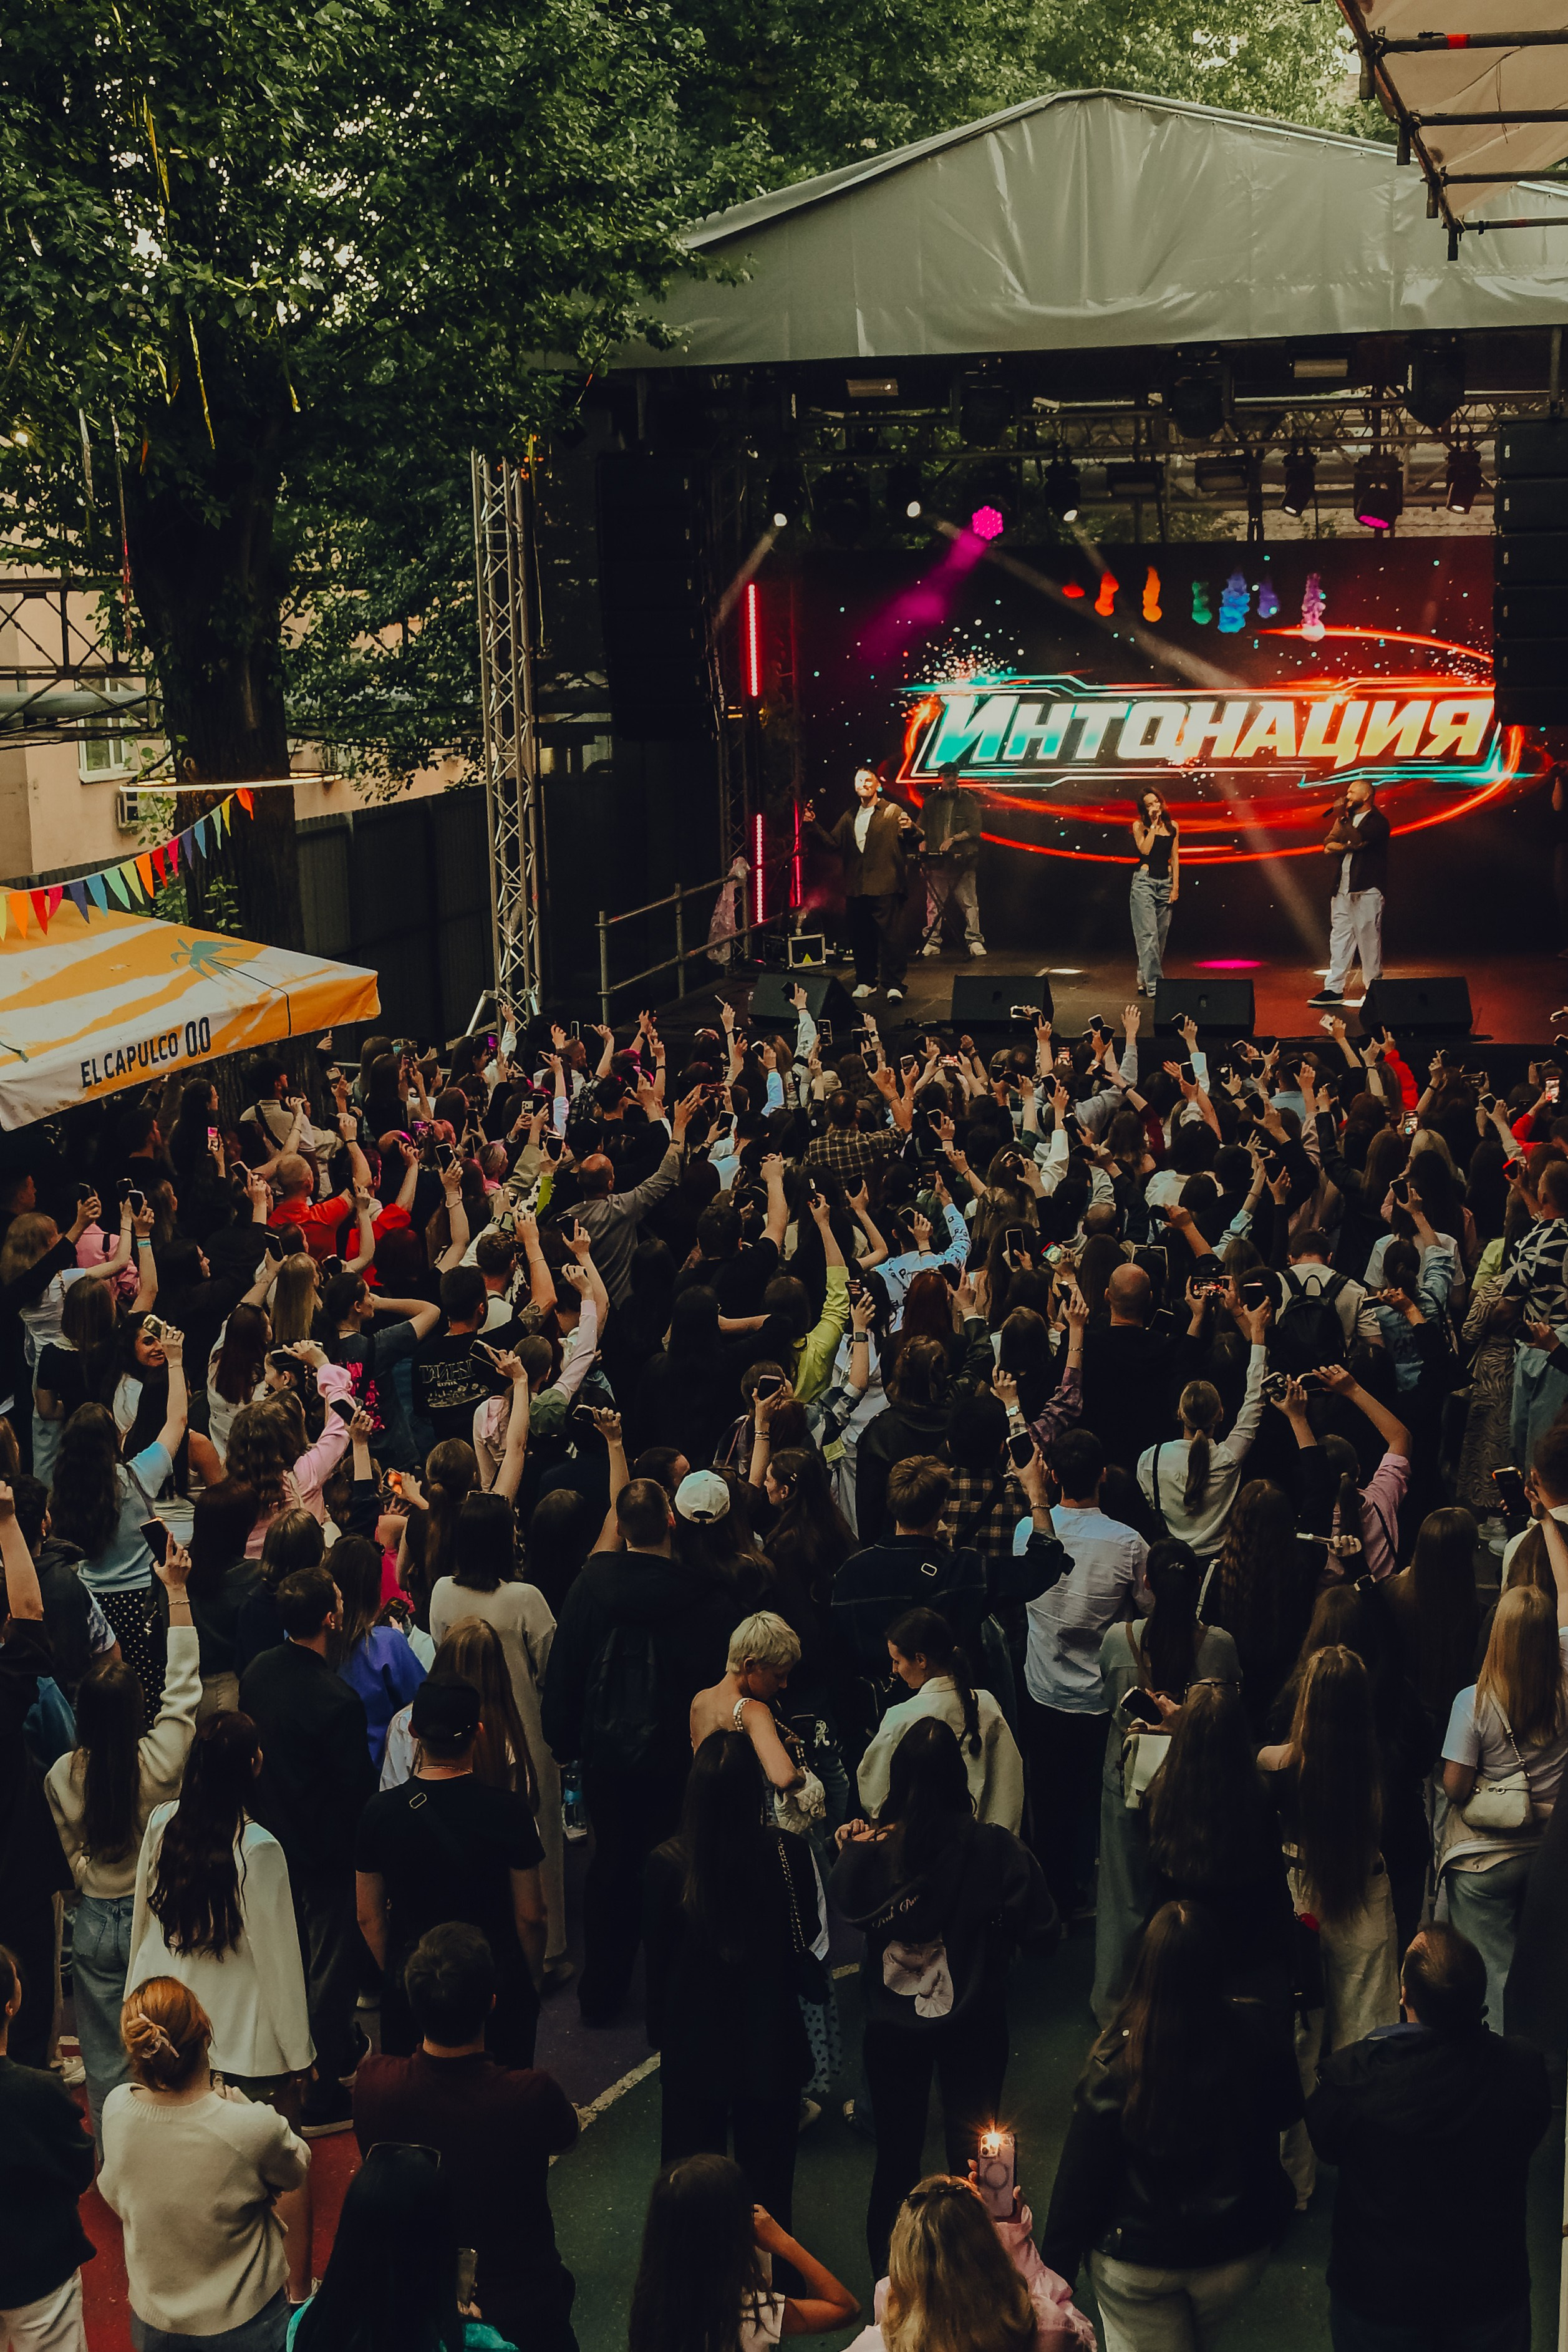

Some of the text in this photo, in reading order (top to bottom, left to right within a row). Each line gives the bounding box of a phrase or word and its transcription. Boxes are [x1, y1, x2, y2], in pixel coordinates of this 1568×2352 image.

[926, 695, 1495, 769] ИНТОНАЦИЯ
[80, 1058, 102, 1088] EL
[104, 1032, 178, 1079] CAPULCO
